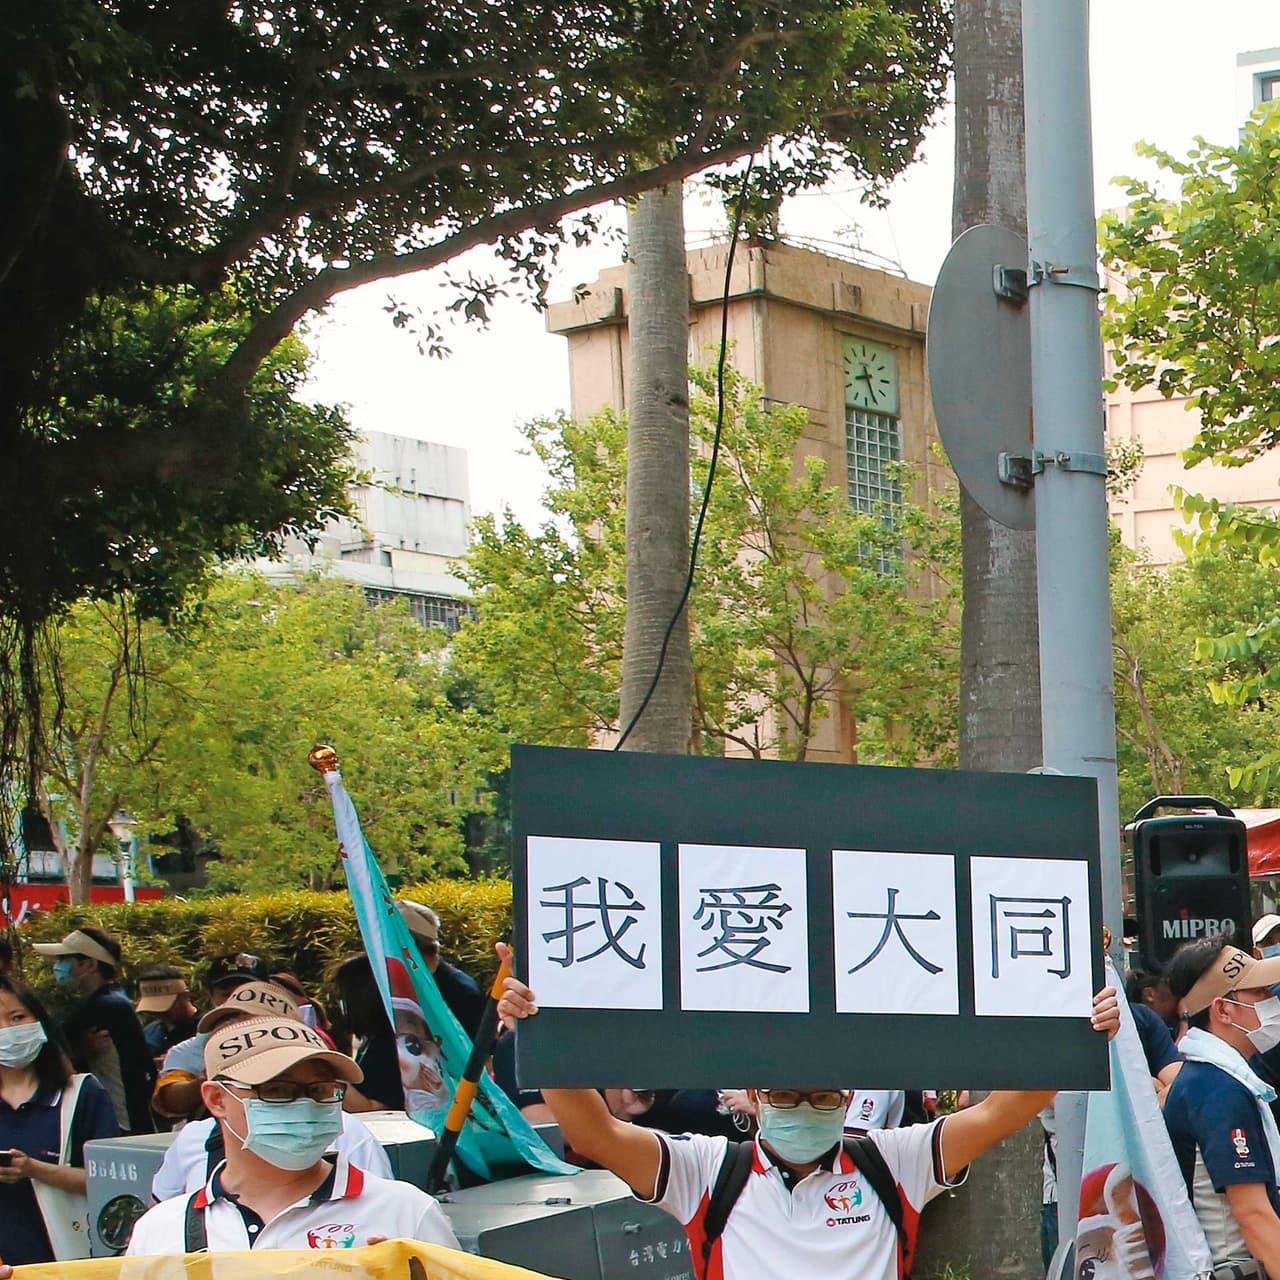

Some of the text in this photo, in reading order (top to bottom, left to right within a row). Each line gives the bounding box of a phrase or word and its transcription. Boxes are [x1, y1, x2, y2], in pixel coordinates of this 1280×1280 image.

[540, 876, 1072, 979] 我愛大同
[1163, 918, 1236, 939] MIPRO
[1223, 951, 1248, 980] SP
[231, 989, 295, 1015] ORT
[836, 1215, 871, 1225] TATUNG
